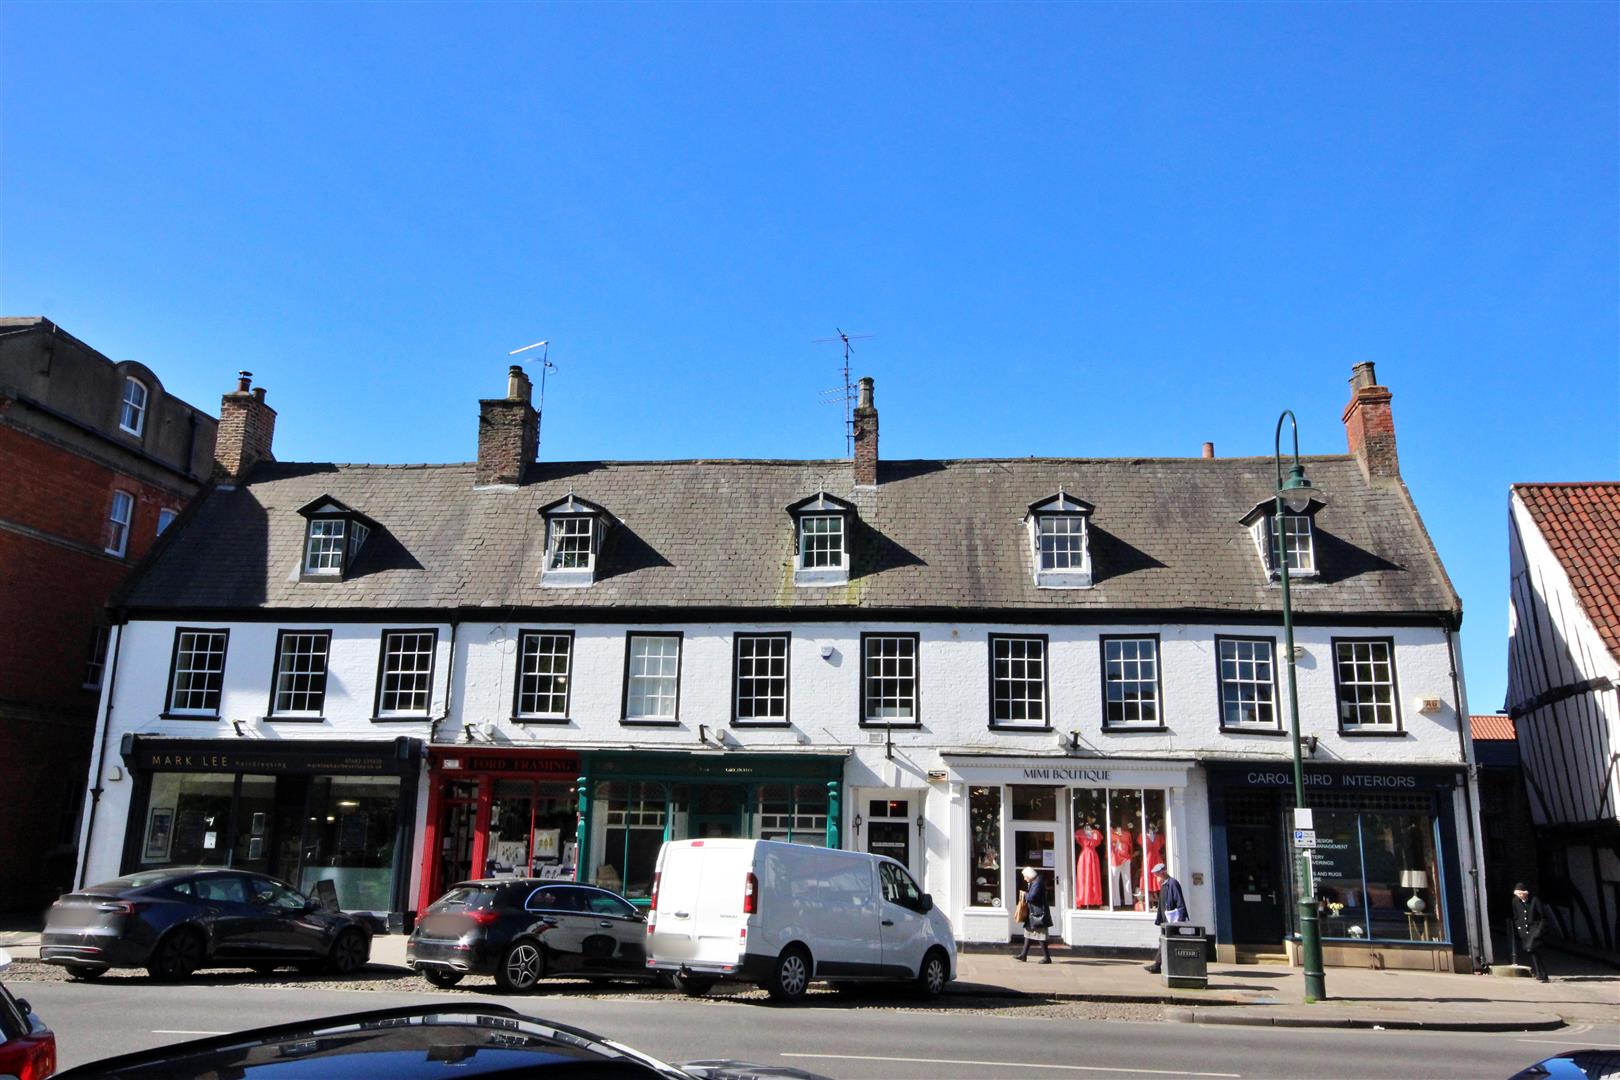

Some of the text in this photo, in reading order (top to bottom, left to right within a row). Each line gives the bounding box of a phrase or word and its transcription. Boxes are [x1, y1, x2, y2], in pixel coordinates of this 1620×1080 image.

[152, 755, 193, 767] MARK
[202, 756, 228, 767] LEE
[473, 759, 571, 772] FORD FRAMING
[1024, 768, 1112, 782] MIMI BOUTIQUE
[1247, 772, 1416, 787] CAROL BIRD INTERIORS
